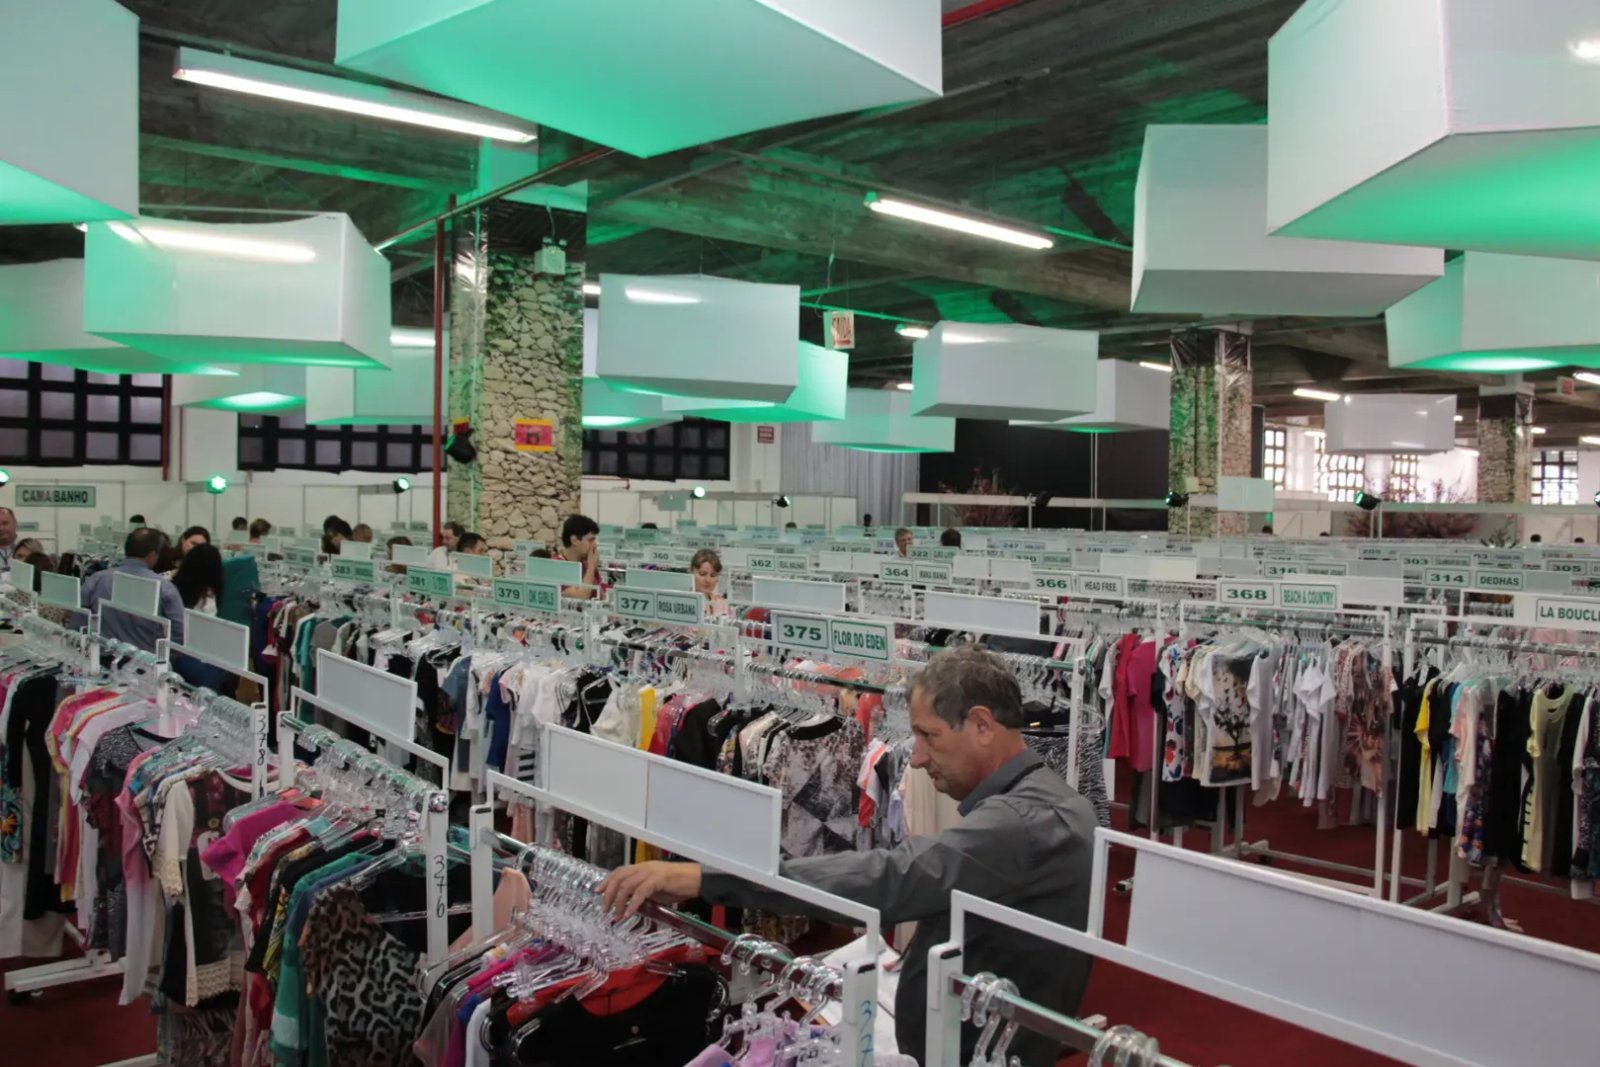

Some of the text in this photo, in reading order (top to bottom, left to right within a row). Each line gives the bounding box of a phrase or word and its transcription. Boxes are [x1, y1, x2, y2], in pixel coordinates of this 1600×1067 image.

[22, 489, 88, 504] CAMA BANHO
[751, 559, 772, 568] 362
[1552, 564, 1582, 572] 305
[884, 567, 909, 577] 364
[1431, 574, 1464, 583] 314
[1035, 578, 1067, 589] 366
[1102, 582, 1117, 592] FREE
[498, 586, 520, 599] 379
[1226, 588, 1268, 600] 368
[621, 597, 650, 611] 377
[658, 600, 673, 614] ROSA
[1540, 606, 1600, 621] LA BOUCL
[783, 624, 822, 641] 375
[833, 629, 852, 647] FLOR
[854, 634, 864, 649] DO
[433, 855, 447, 919] 376
